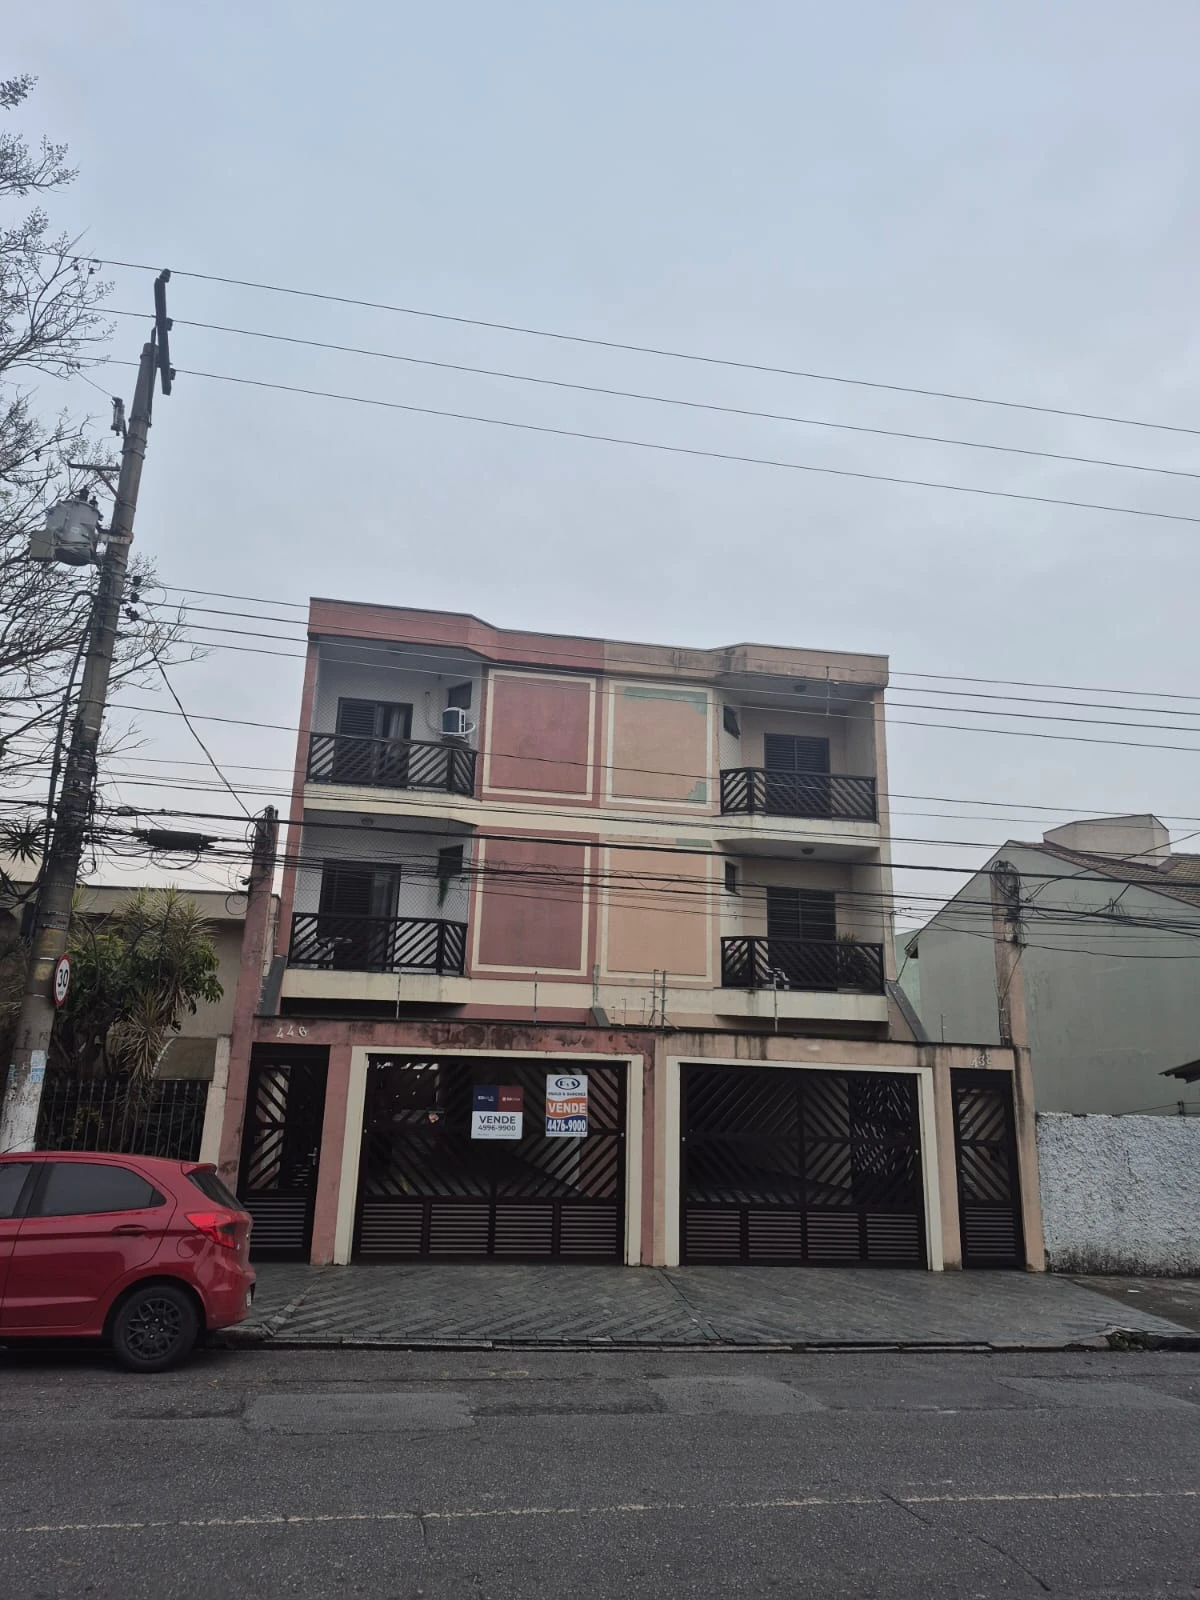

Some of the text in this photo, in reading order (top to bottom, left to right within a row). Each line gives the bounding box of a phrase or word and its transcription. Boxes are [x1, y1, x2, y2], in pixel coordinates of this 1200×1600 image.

[57, 968, 69, 988] 30
[276, 1025, 307, 1038] 446
[548, 1102, 586, 1114] VENDE
[479, 1115, 516, 1124] VENDE
[547, 1119, 586, 1132] 4476-9000
[477, 1124, 516, 1132] 4996-9900
